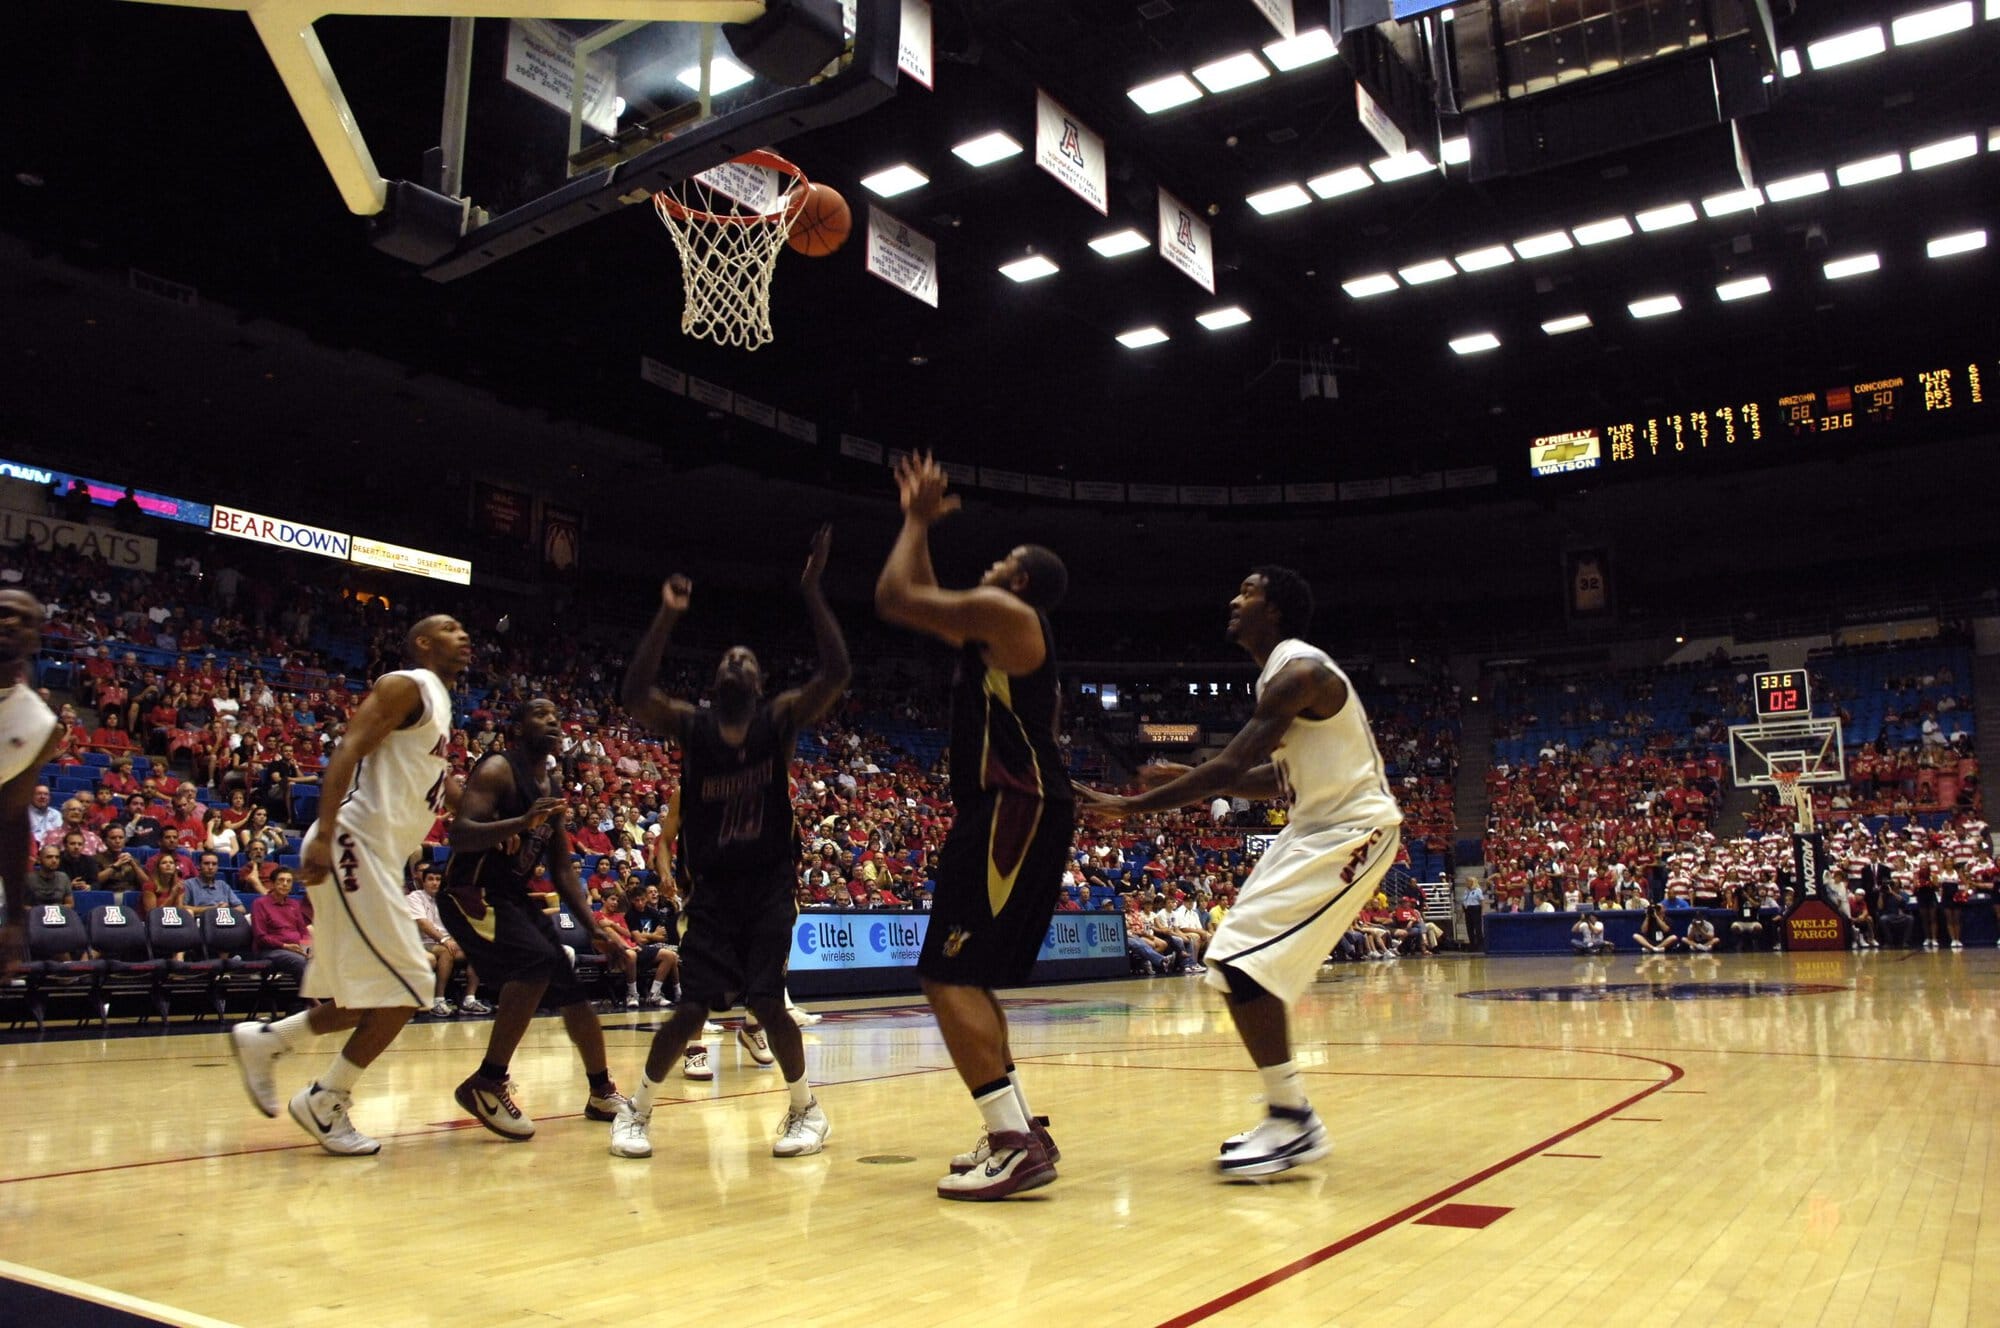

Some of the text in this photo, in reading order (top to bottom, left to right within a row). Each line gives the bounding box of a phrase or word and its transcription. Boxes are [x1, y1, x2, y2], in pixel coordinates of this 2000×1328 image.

[1060, 118, 1084, 168] A
[1178, 210, 1196, 254] A
[1919, 364, 1978, 383] PLYR 6
[1854, 377, 1904, 394] CONCORDIA
[1924, 388, 1951, 400] RBS
[1926, 380, 1948, 392] PTS
[1779, 392, 1816, 406] ARIZONA
[1874, 391, 1892, 406] 50
[1926, 398, 1952, 411] FLS
[1608, 403, 1758, 436] PLYR 5 13 34 42 43
[1792, 405, 1810, 420] 68
[1612, 432, 1632, 444] PTS
[1674, 424, 1682, 433] 9
[1692, 420, 1707, 430] 17
[1744, 412, 1760, 422] 12
[1820, 414, 1852, 432] 33.6
[1535, 430, 1592, 447] O'RIELLY
[1612, 441, 1634, 452] RBS
[1700, 428, 1708, 438] 3
[1726, 425, 1734, 434] 3
[1752, 422, 1760, 430] 4
[1612, 450, 1634, 461] FLS
[1676, 442, 1684, 450] 0
[1726, 434, 1735, 444] 0
[1752, 430, 1761, 440] 3
[0, 463, 52, 484] OWN
[1538, 458, 1596, 476] WATSON
[2, 512, 141, 565] LDCATS
[352, 544, 380, 556] DESERT
[382, 550, 409, 561] TOYOTA
[416, 558, 442, 568] DESERT
[444, 564, 470, 574] TOYOTA
[1761, 674, 1792, 689] 33.6
[310, 692, 320, 701] 15
[1770, 690, 1797, 711] 02
[338, 833, 360, 892] CATS
[1340, 829, 1382, 884] CATS
[1801, 838, 1817, 896] ARIZONA
[43, 906, 66, 925] A
[104, 906, 126, 925] A
[162, 906, 182, 926] A
[216, 907, 236, 926] A
[1790, 919, 1838, 929] WELLS
[808, 922, 855, 948] alltel
[879, 922, 920, 948] alltel
[1050, 922, 1080, 944] alltel
[1092, 922, 1120, 942] alltel
[1793, 930, 1838, 940] FARGO
[821, 950, 856, 962] wireless
[890, 950, 922, 960] wireless
[1059, 946, 1082, 954] wireless
